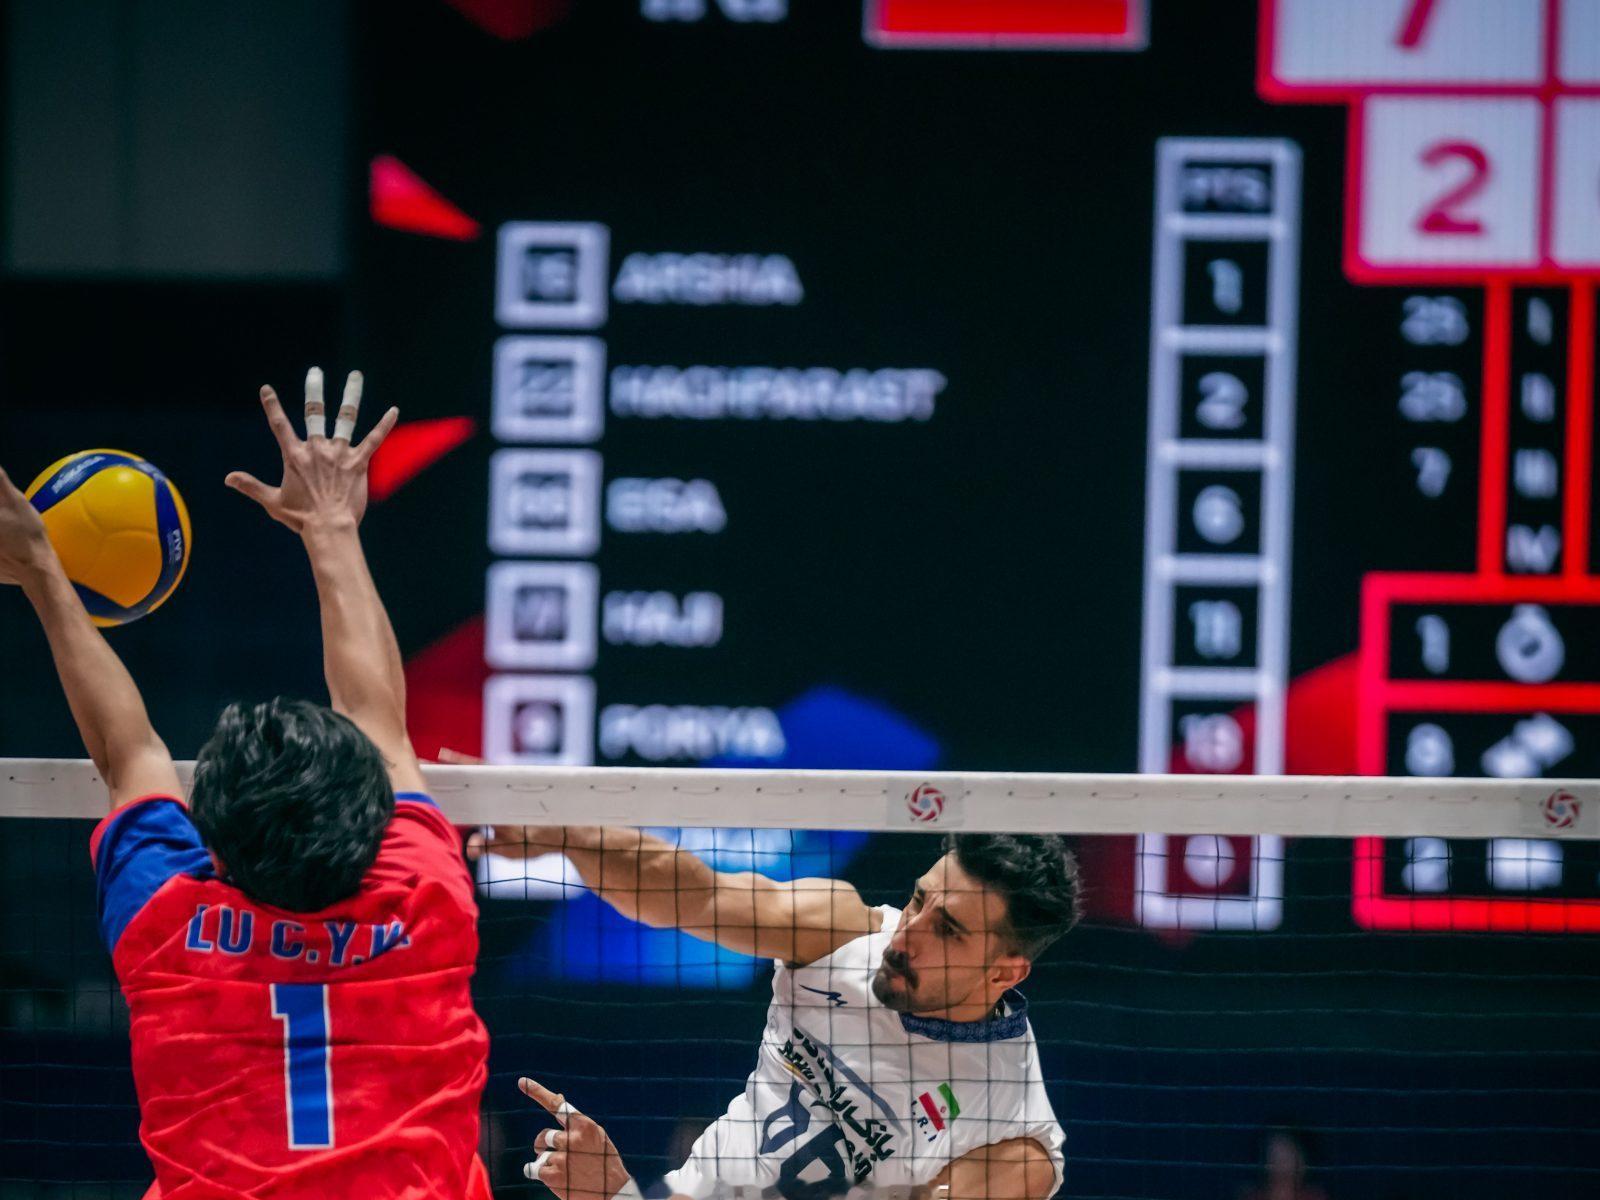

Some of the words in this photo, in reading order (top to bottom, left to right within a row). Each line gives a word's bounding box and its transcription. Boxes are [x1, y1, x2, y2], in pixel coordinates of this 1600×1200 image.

[1417, 138, 1493, 236] 2
[612, 252, 804, 304] ARSHIA
[1206, 257, 1243, 314] 1
[1400, 295, 1469, 347] 25
[1196, 371, 1249, 430] 2
[1399, 371, 1468, 422] 25
[1411, 446, 1452, 498] 7
[1415, 613, 1451, 674] 1
[184, 903, 254, 957] LU
[270, 983, 334, 1150] 1
